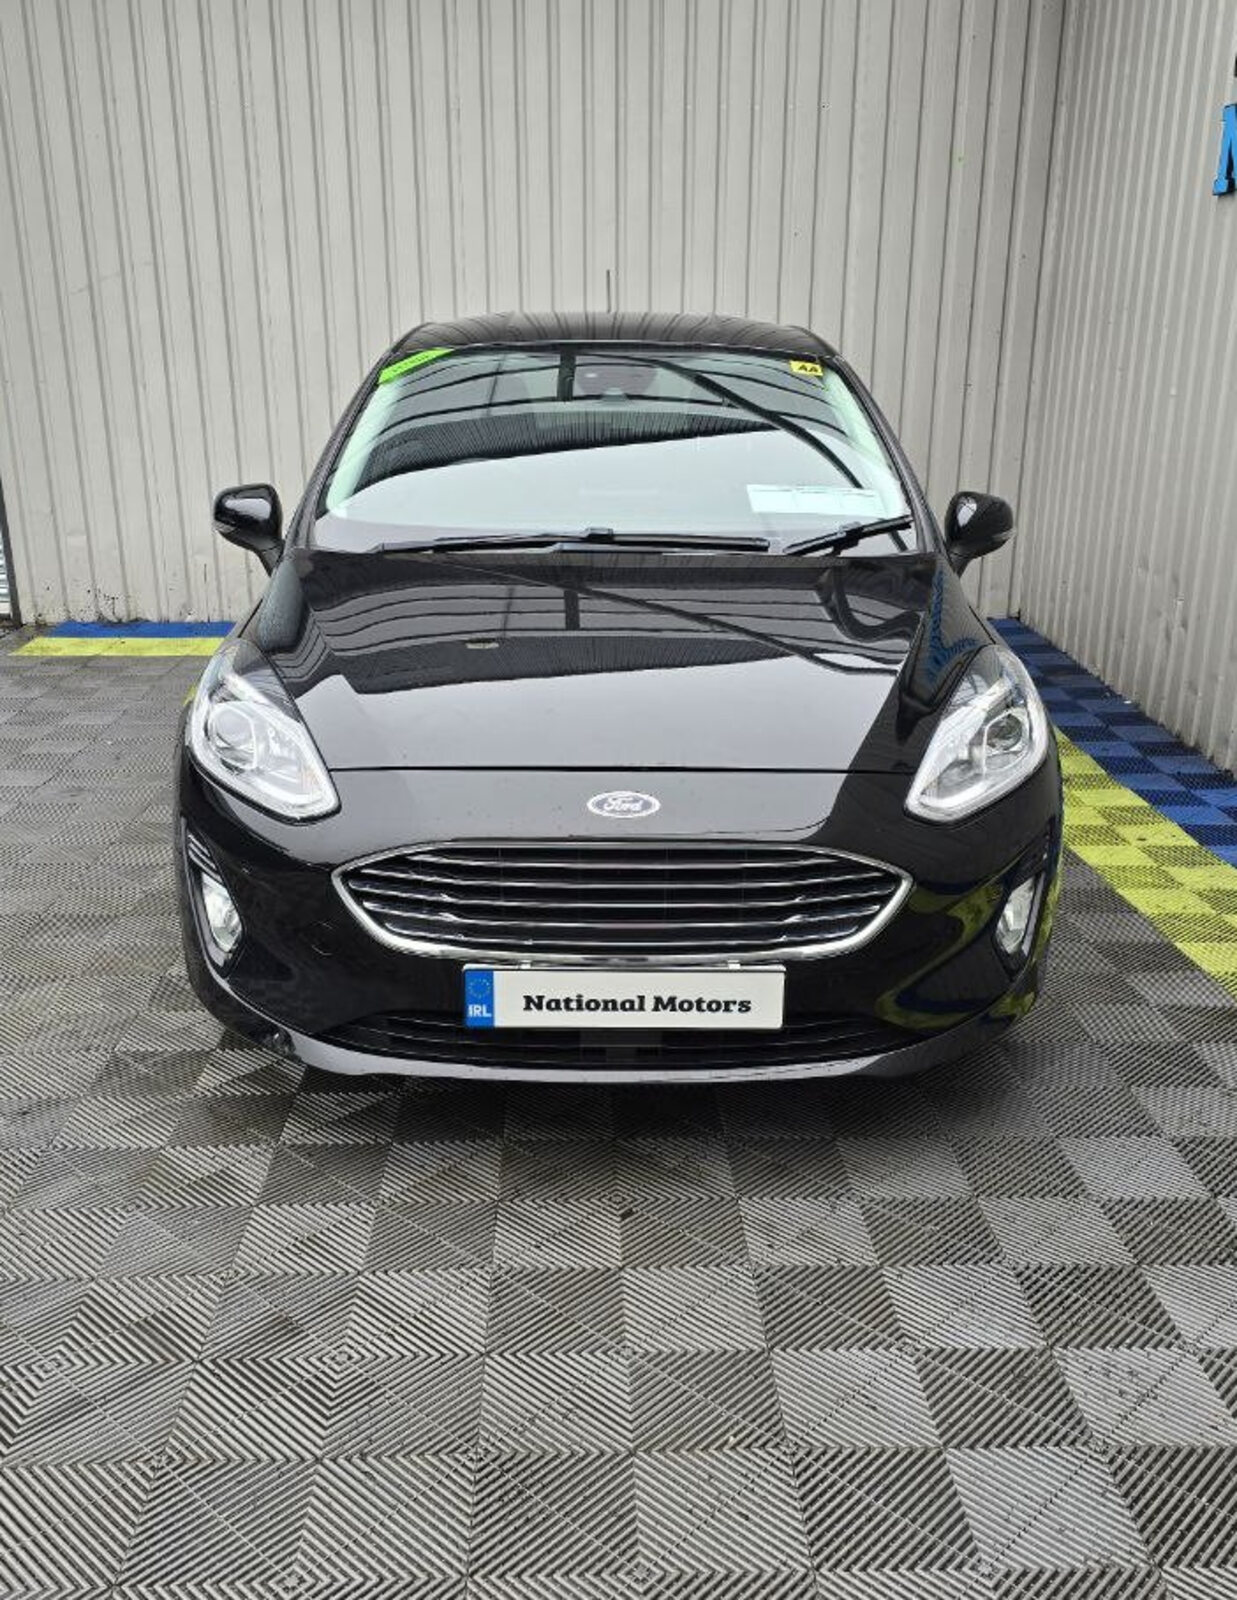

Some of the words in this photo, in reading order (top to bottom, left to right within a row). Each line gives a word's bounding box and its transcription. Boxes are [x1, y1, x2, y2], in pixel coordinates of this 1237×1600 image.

[603, 796, 644, 812] Ford
[468, 1004, 492, 1018] IRL
[522, 993, 646, 1013] National
[651, 995, 752, 1013] Motors
